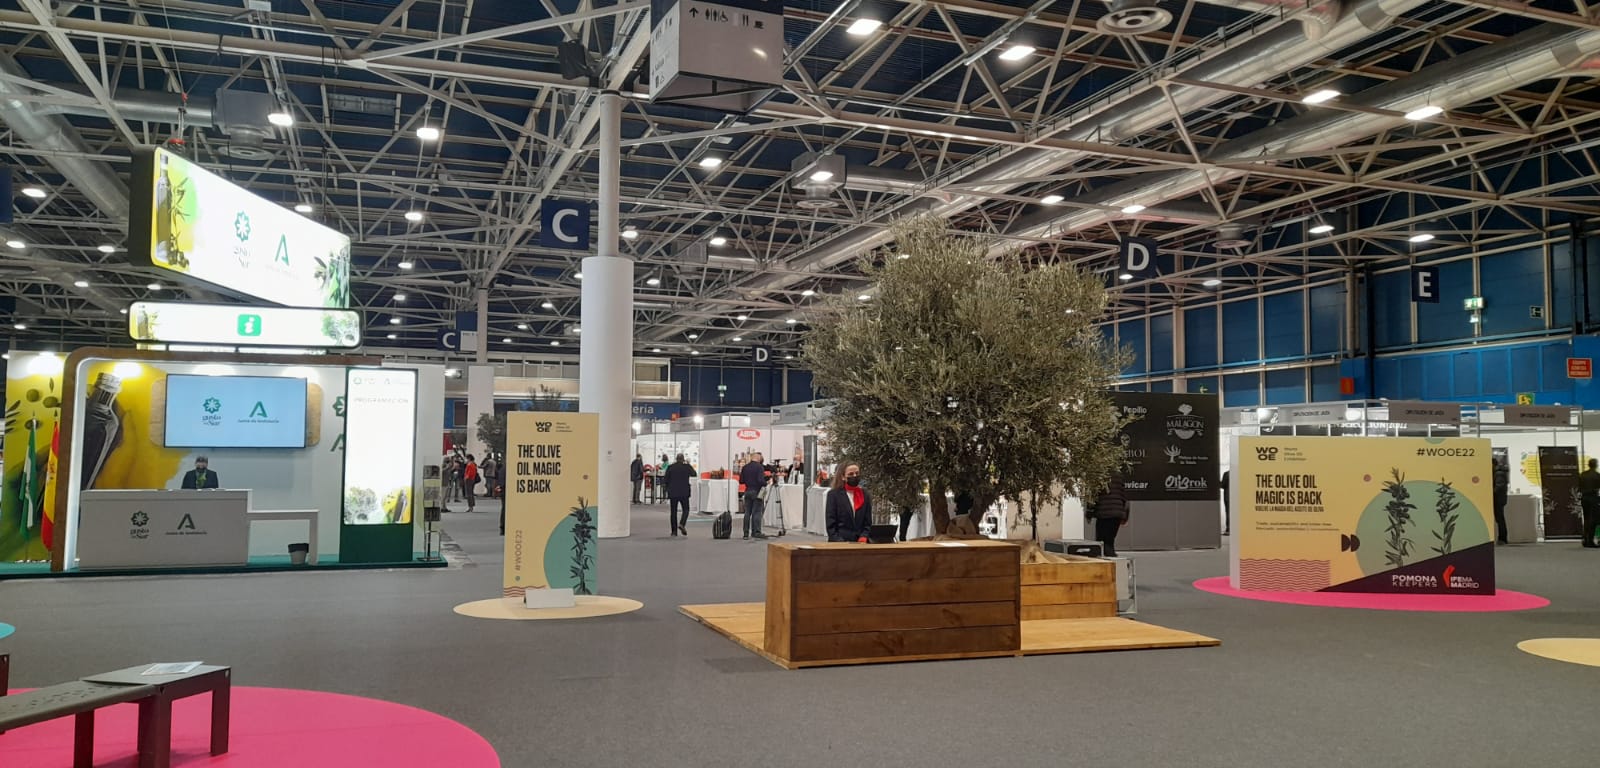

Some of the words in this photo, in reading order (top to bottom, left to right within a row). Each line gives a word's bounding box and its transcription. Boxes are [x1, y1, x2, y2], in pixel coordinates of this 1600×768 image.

[552, 208, 578, 242] C
[1127, 242, 1150, 270] D
[1418, 271, 1432, 297] E
[442, 332, 456, 348] C
[755, 347, 768, 362] D
[517, 444, 535, 458] THE
[536, 444, 561, 458] OLIVE
[1416, 448, 1475, 457] #WOOE22
[517, 462, 531, 475] OIL
[532, 462, 561, 475] MAGIC
[516, 479, 526, 493] IS
[527, 479, 551, 493] BACK
[1255, 474, 1273, 488] THE
[1275, 474, 1301, 488] OLIVE
[1302, 474, 1317, 488] OIL
[1255, 491, 1285, 505] MAGIC
[1286, 491, 1296, 505] IS
[1297, 491, 1322, 505] BACK
[514, 529, 522, 571] #WOOE22
